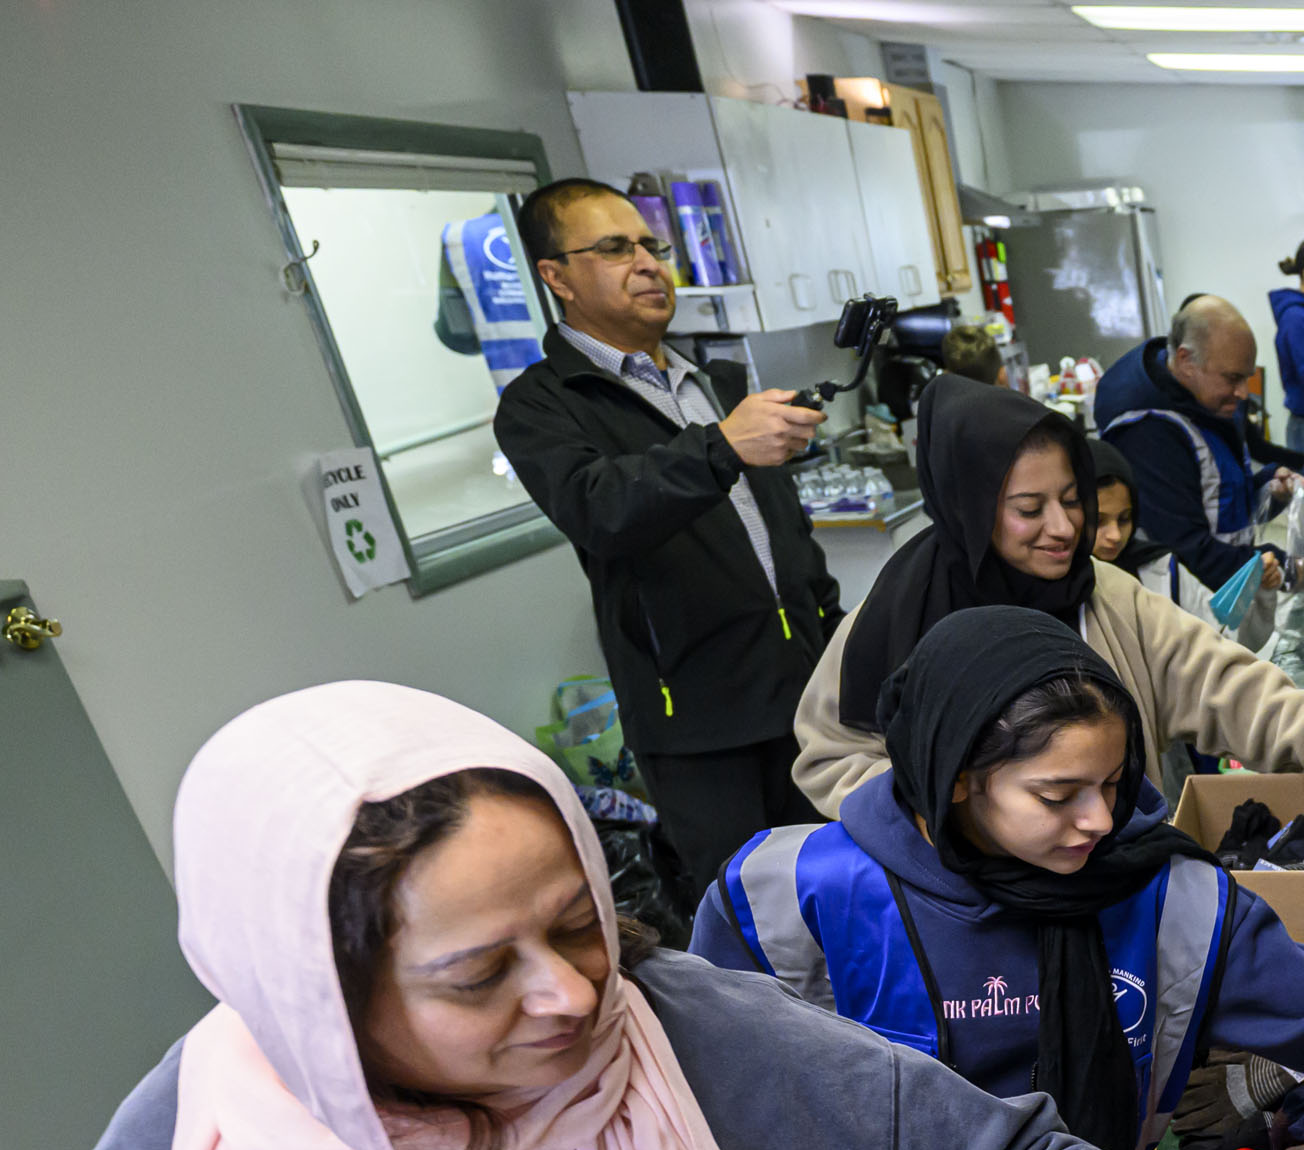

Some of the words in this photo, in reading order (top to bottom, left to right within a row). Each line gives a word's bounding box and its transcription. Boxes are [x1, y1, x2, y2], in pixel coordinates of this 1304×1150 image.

[1112, 967, 1146, 988] MANKIND
[943, 999, 966, 1019] NK
[971, 988, 1020, 1018] PALM
